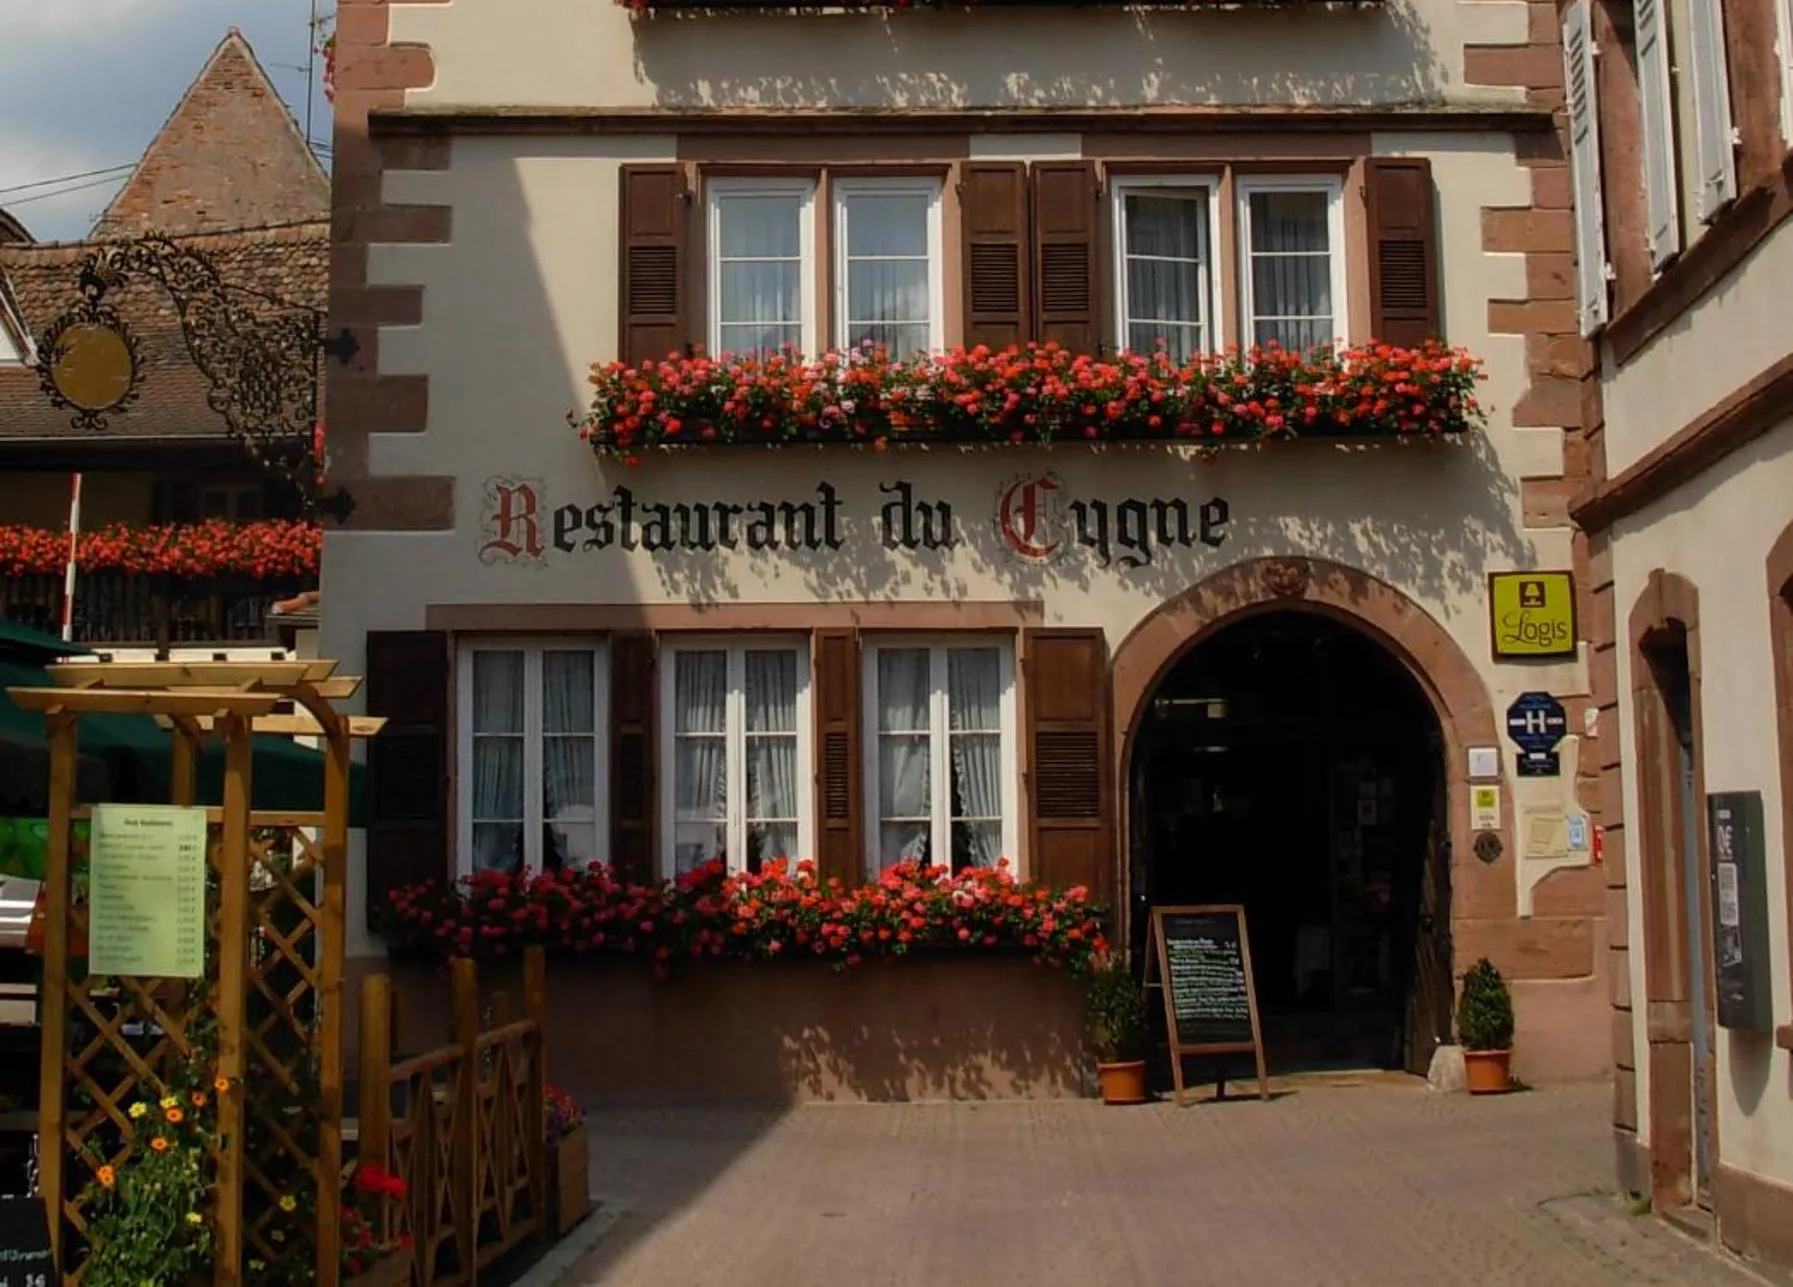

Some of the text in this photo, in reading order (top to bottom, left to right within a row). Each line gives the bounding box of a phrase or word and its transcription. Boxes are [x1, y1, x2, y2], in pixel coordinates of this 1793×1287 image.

[478, 475, 1230, 567] Restaurant du Cygne
[1503, 611, 1567, 647] Logis
[1526, 710, 1546, 734] H
